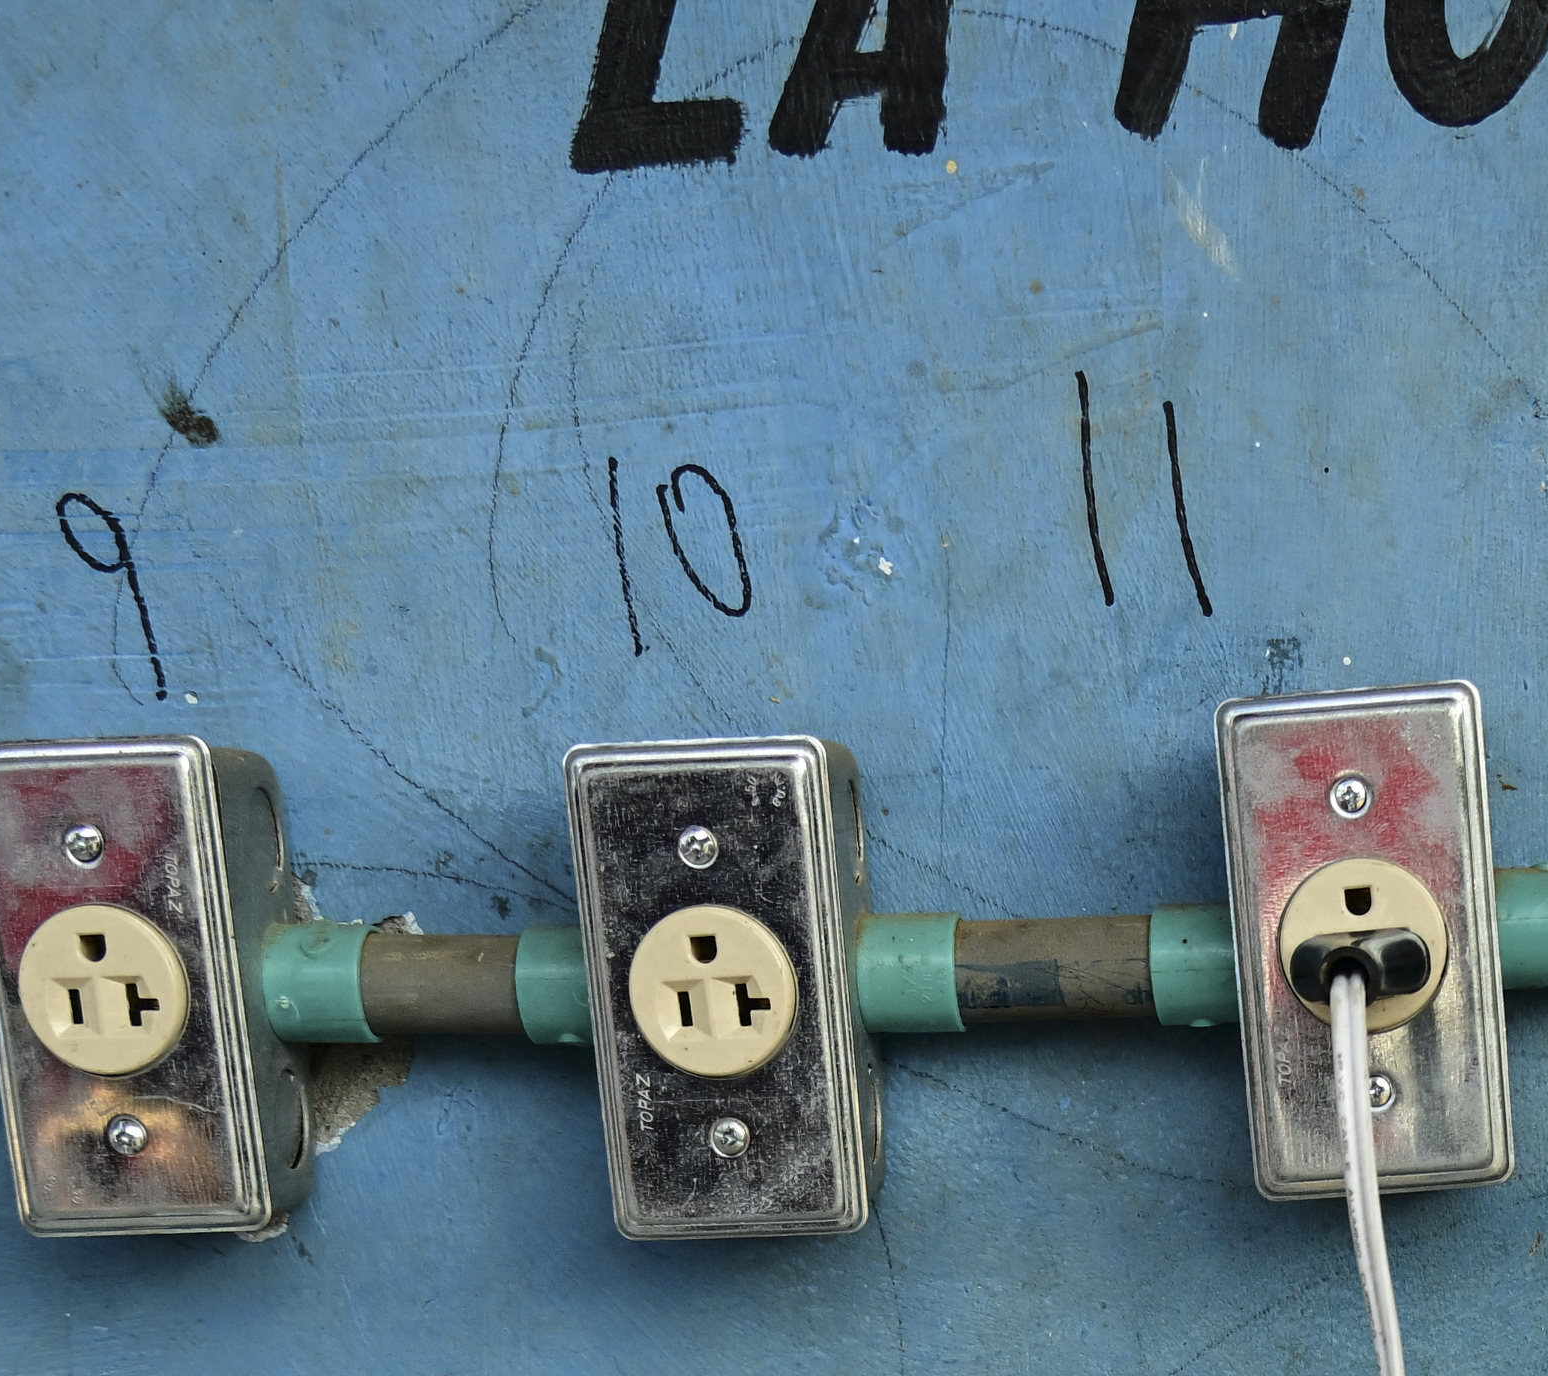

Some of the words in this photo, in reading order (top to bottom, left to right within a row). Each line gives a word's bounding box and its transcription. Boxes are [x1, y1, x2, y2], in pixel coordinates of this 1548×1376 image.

[569, 0, 952, 174] LA
[607, 455, 753, 657] 10
[1073, 368, 1215, 618] 11
[56, 492, 169, 702] 9
[163, 853, 185, 915] TOPAZ
[635, 1073, 655, 1132] TOPAZ
